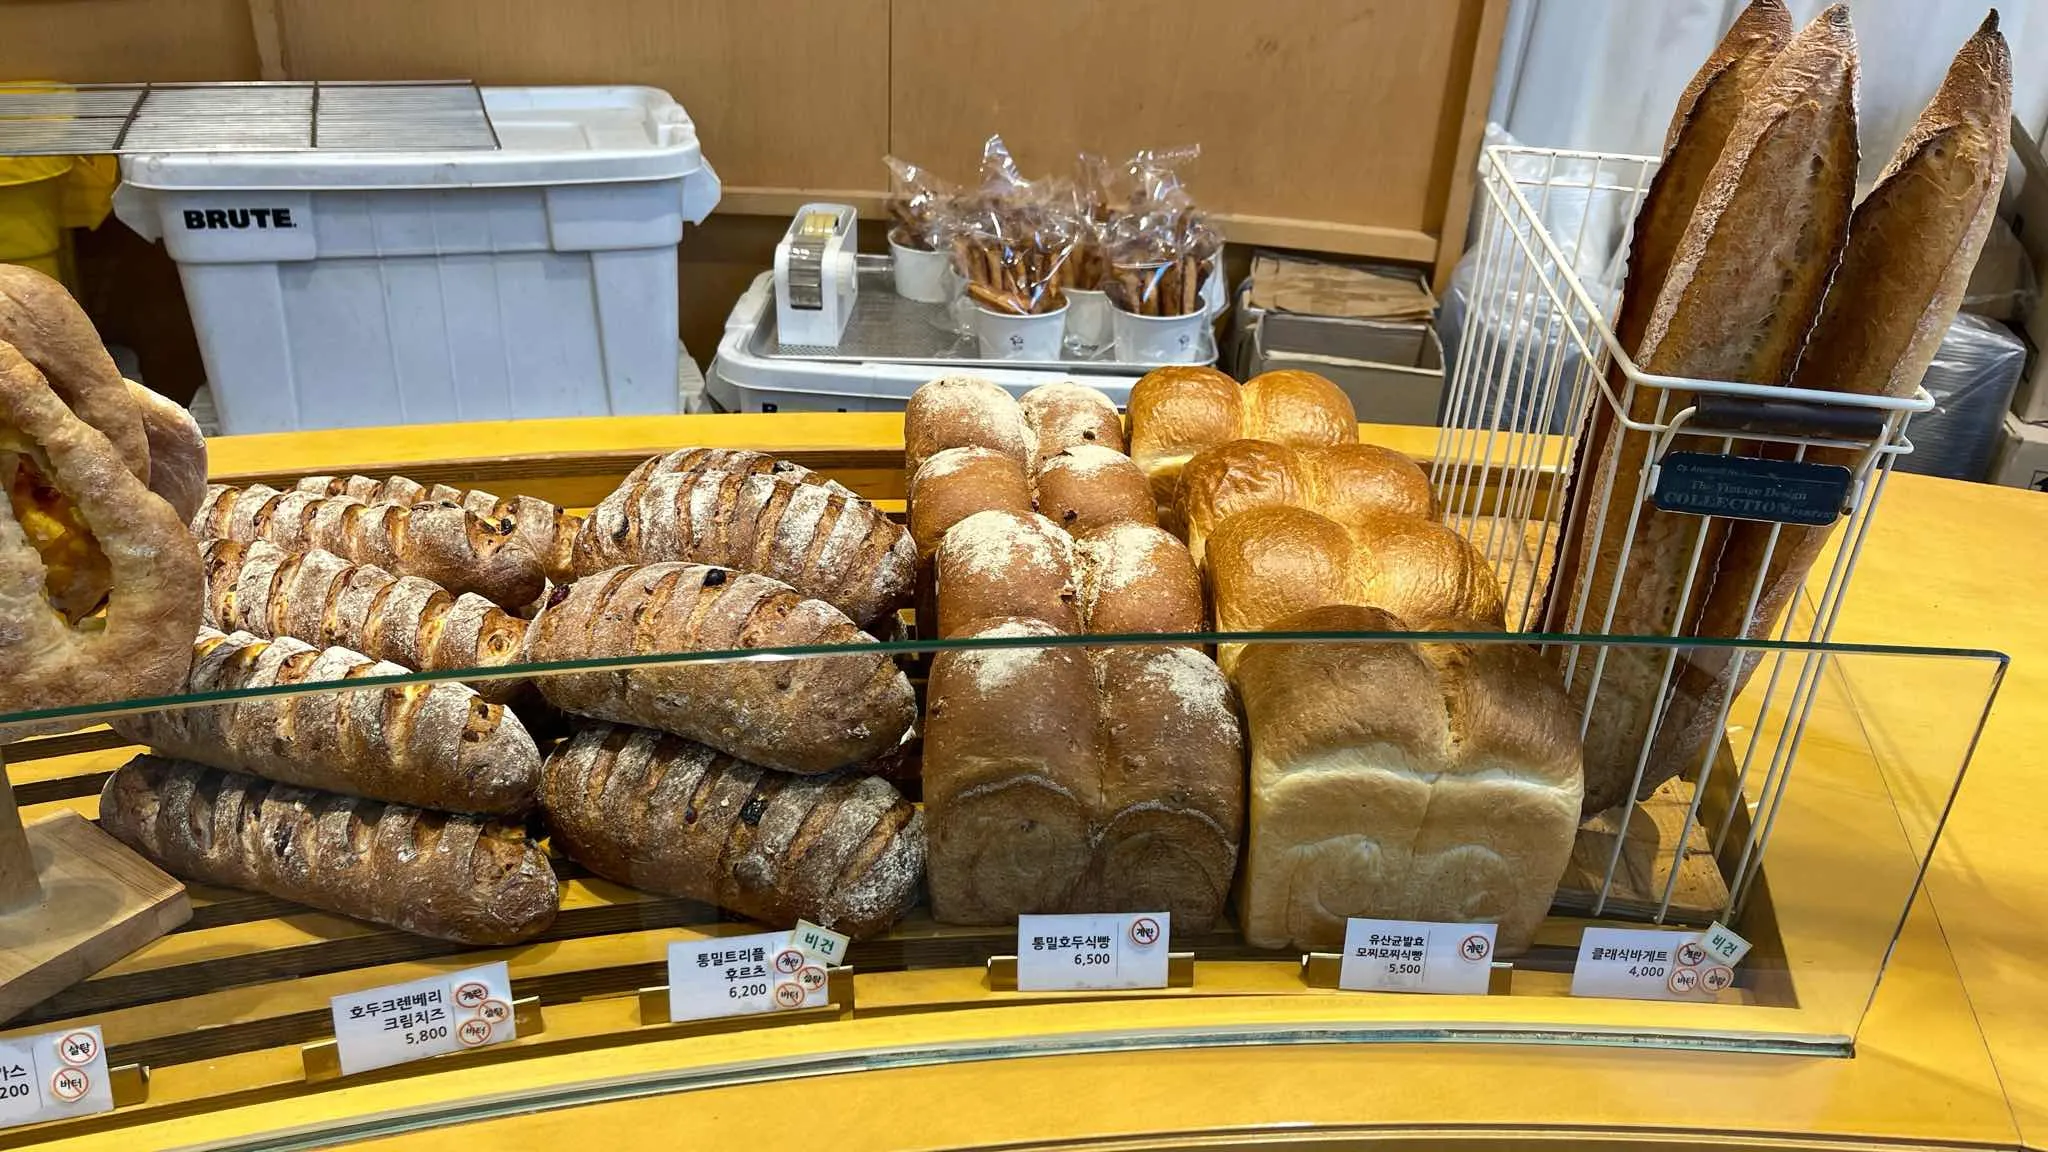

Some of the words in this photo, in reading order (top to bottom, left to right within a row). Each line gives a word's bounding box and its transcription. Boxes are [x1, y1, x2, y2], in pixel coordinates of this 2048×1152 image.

[804, 932, 836, 957] 비건
[1031, 936, 1111, 951] 통밀호두식빵
[1369, 934, 1425, 948] 유산균발효
[1711, 934, 1739, 958] 비건
[696, 947, 766, 968] 통밀트리플
[1074, 953, 1111, 966] 6,500
[1355, 948, 1424, 962] 모찌모찌식빵
[1591, 948, 1668, 963] 클래식바게트
[725, 966, 767, 982] 후르츠
[1388, 963, 1421, 975] 5,500
[1629, 966, 1665, 978] 4,000
[1677, 976, 1695, 986] 버터
[729, 984, 767, 999] 6,200
[780, 989, 799, 1000] 버터
[349, 989, 443, 1020] 호두크렌베리
[383, 1008, 445, 1031] 크림치즈
[405, 1026, 448, 1045] 5,800
[465, 1026, 486, 1037] 버터
[60, 1078, 82, 1089] 버터
